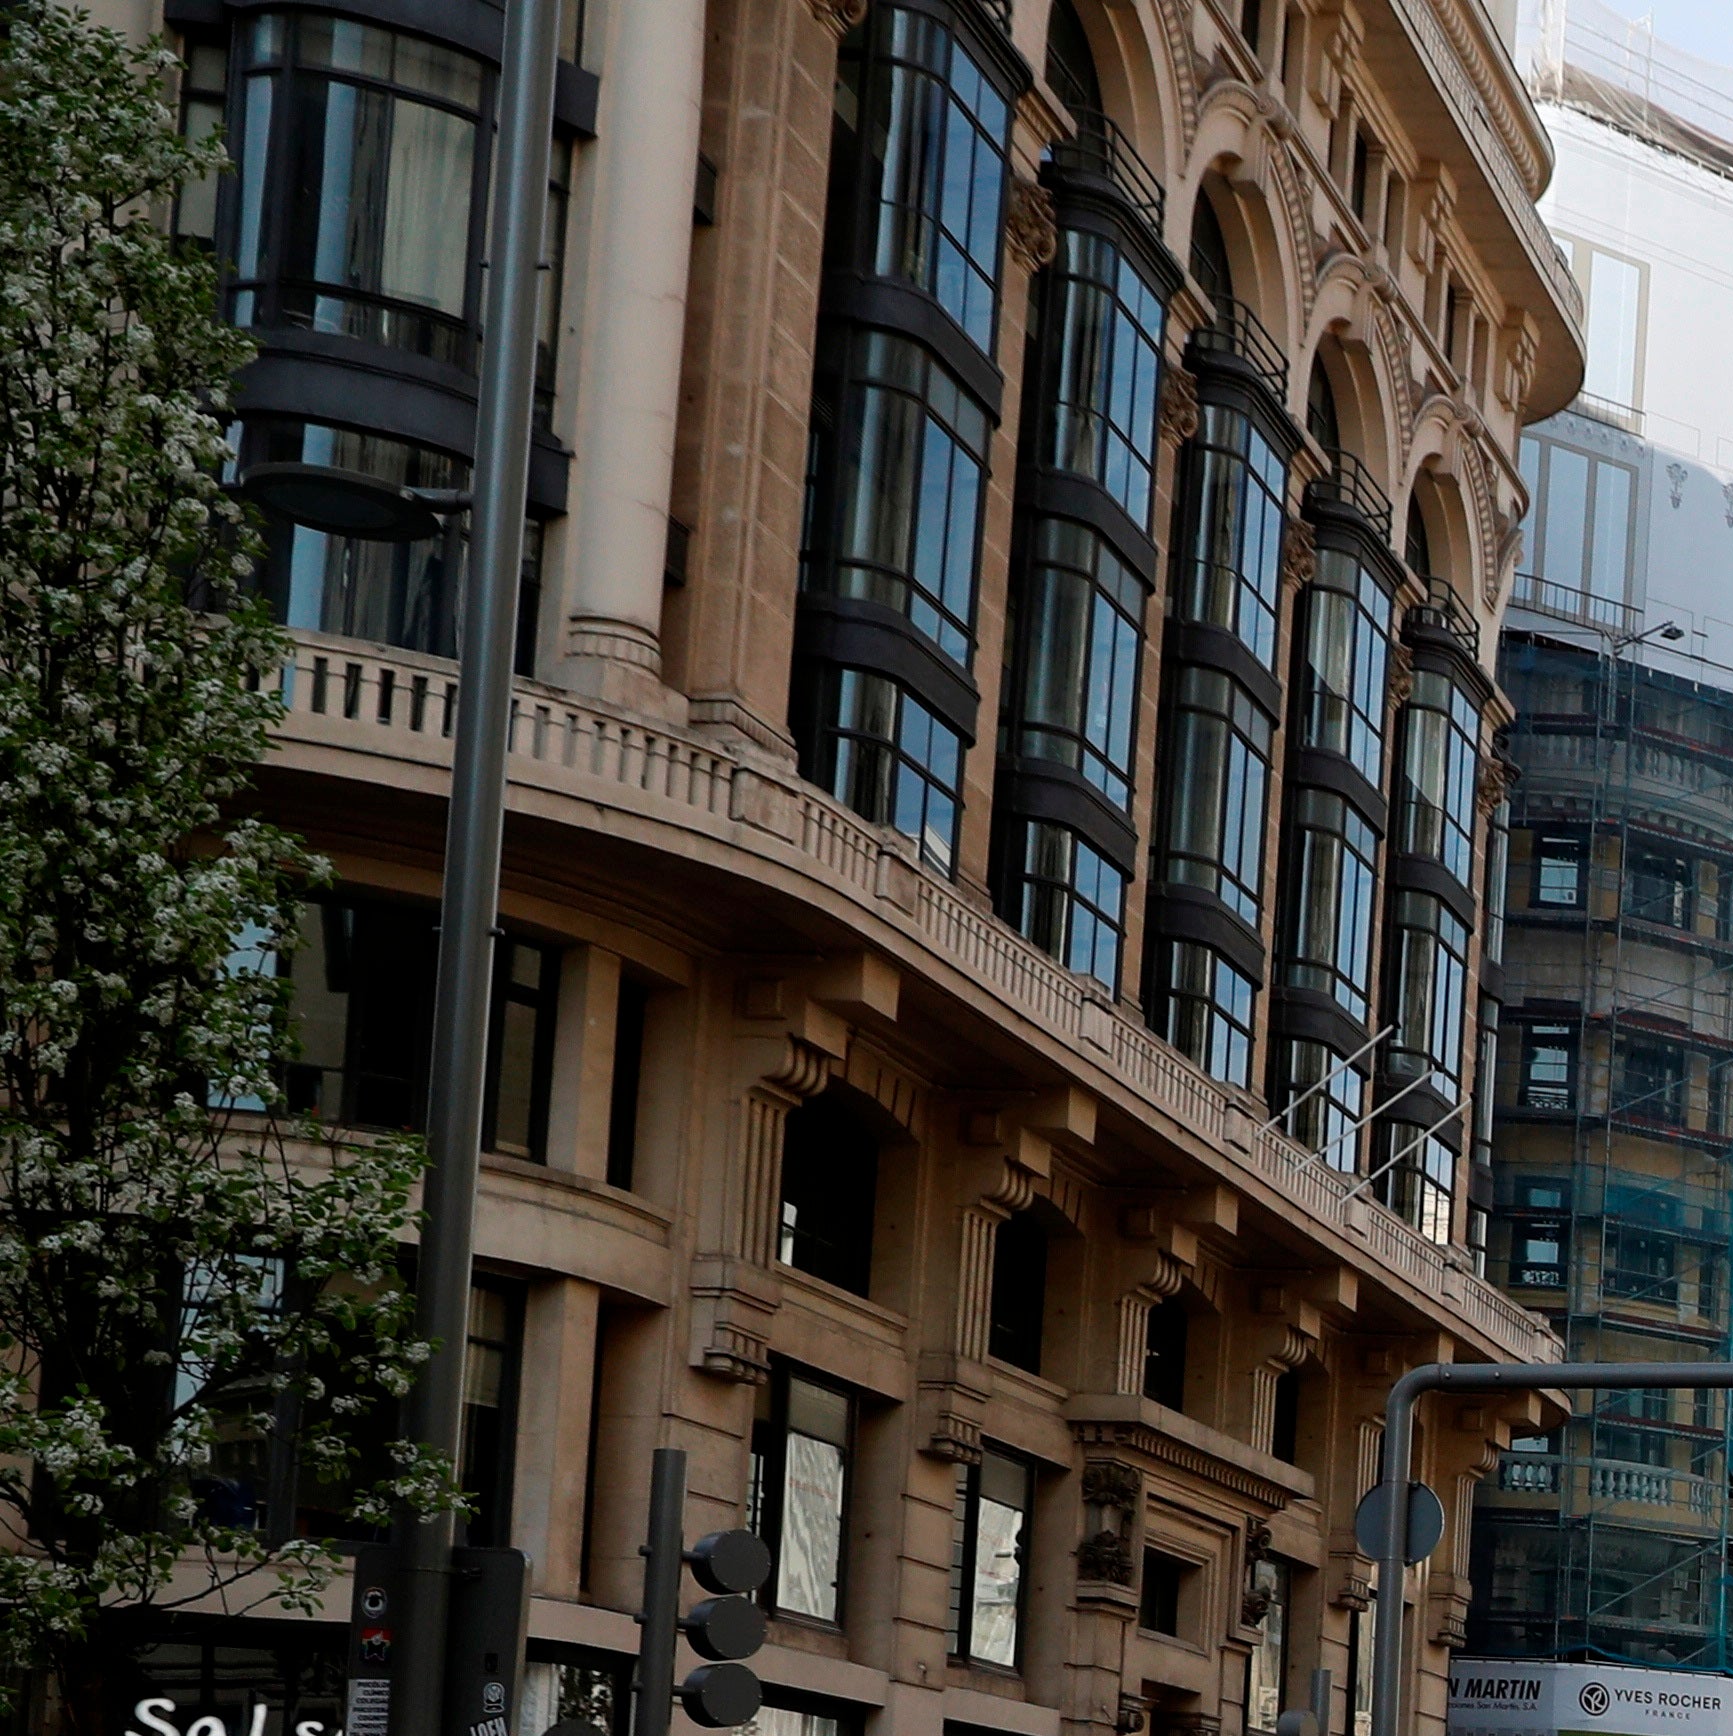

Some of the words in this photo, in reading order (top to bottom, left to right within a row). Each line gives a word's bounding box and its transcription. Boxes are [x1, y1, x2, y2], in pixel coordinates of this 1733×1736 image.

[1463, 1679, 1542, 1700] MARTIN
[1614, 1688, 1653, 1705] YVES
[1658, 1693, 1722, 1711] ROCHER
[1645, 1709, 1692, 1721] FRANCE
